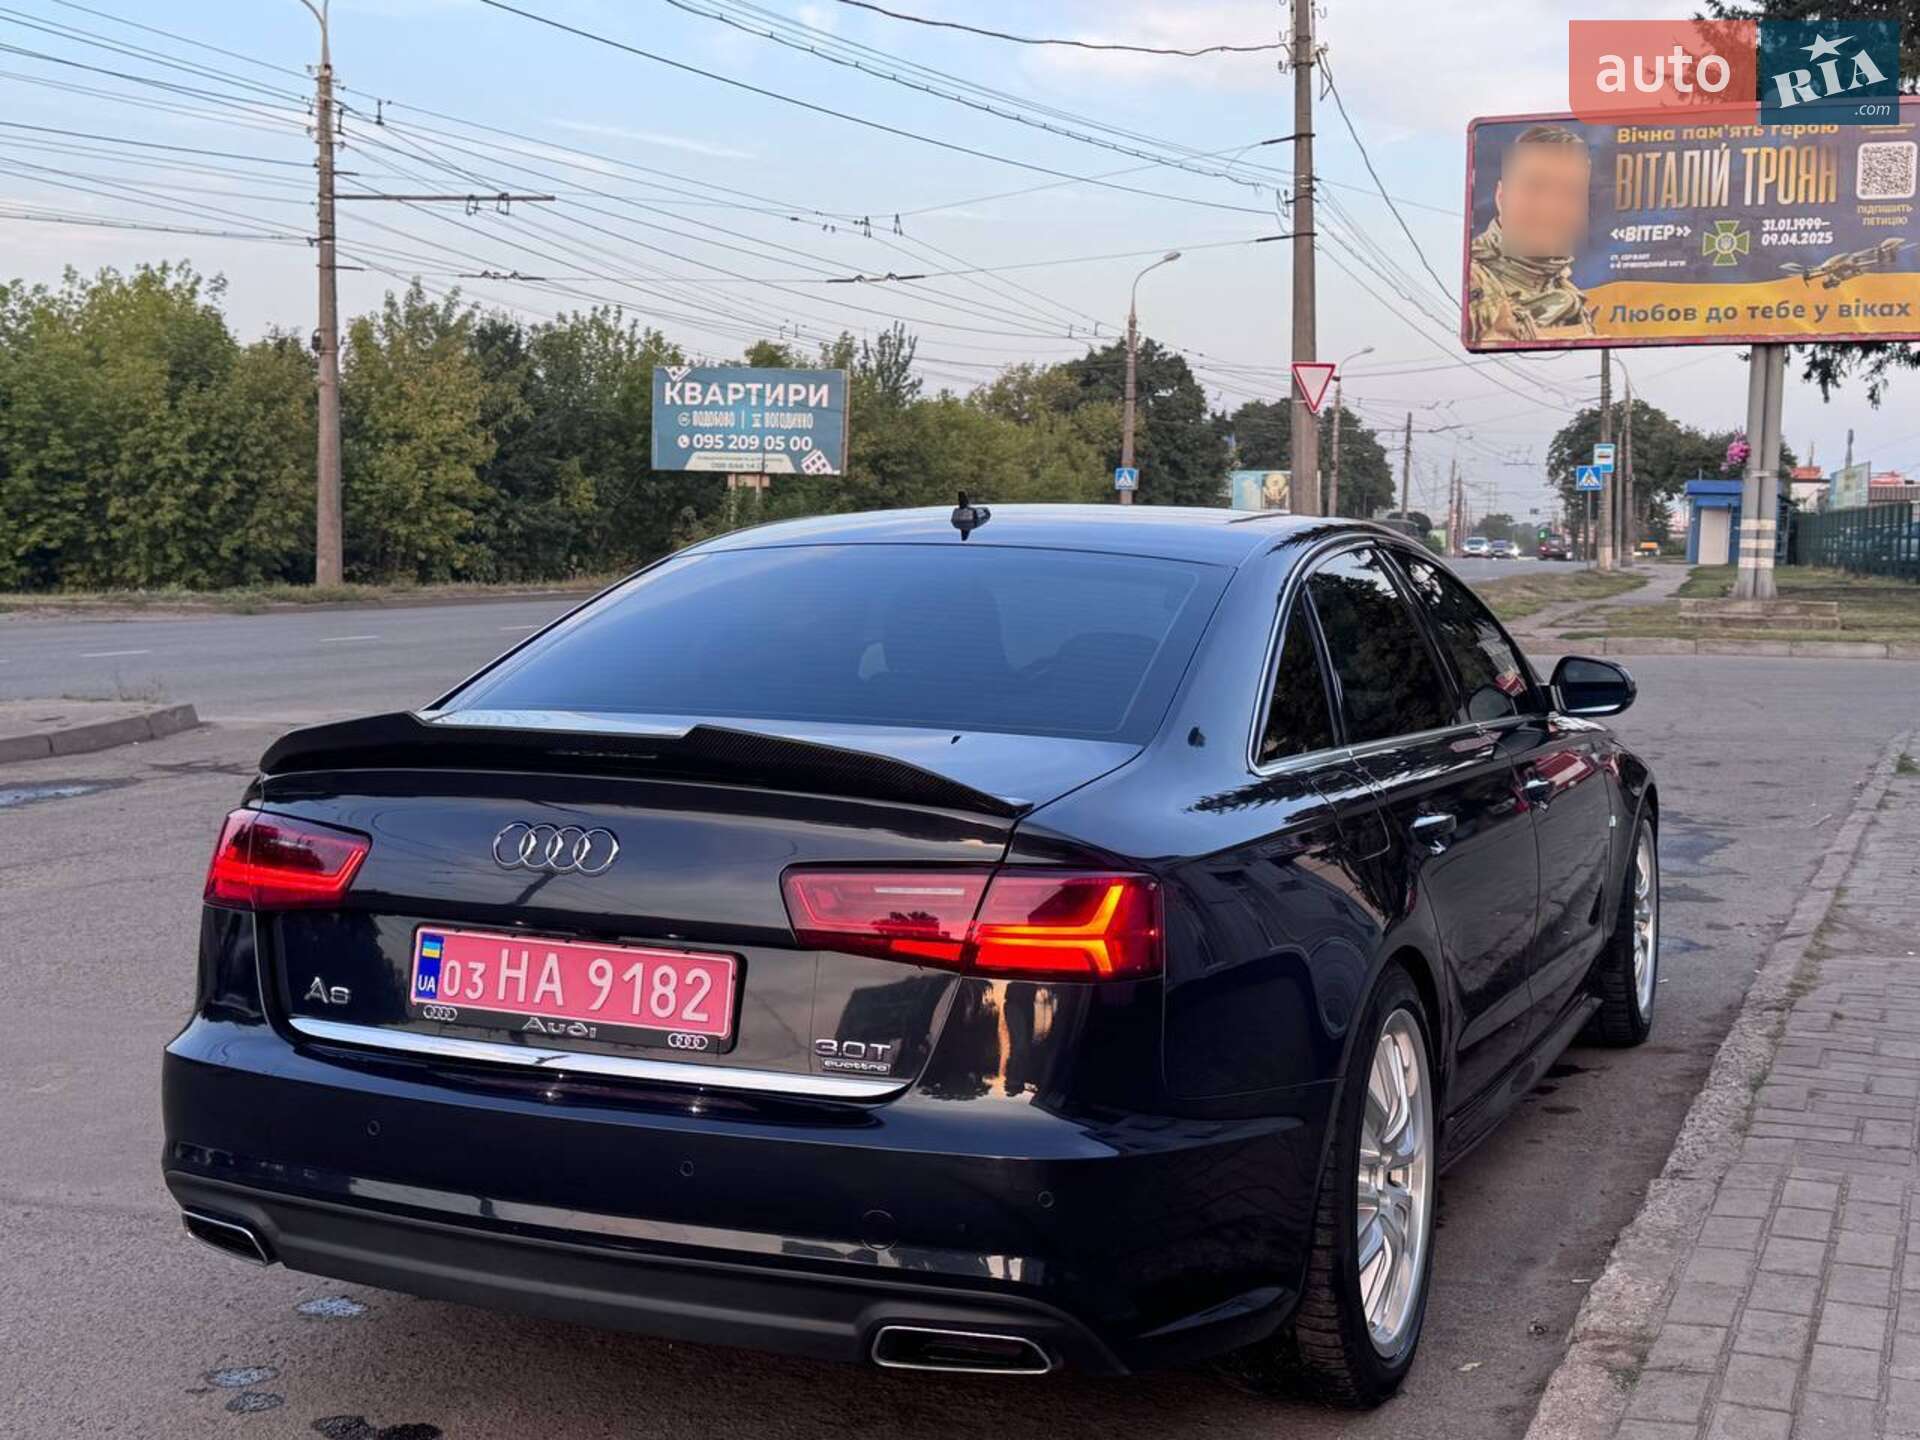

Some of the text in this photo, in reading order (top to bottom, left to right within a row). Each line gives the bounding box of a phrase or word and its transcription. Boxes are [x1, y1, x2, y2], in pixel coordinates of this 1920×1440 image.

[1616, 127, 1676, 144] Вічна
[1682, 123, 1765, 140] пам'ять
[1771, 124, 1840, 139] герою
[1615, 143, 1838, 212] ВІТАЛІЙ ТРОЯН
[1761, 231, 1834, 246] 09.04.2025
[1609, 298, 1910, 323] Любов до тебе у віках
[664, 382, 829, 408] КВАРТИРИ
[692, 434, 812, 451] 095 209 05 00
[417, 974, 437, 993] UA
[443, 948, 712, 1023] 03 HA 9182
[521, 1016, 597, 1039] Audi
[815, 1038, 891, 1060] 3.0T
[824, 1059, 888, 1073] quattro
